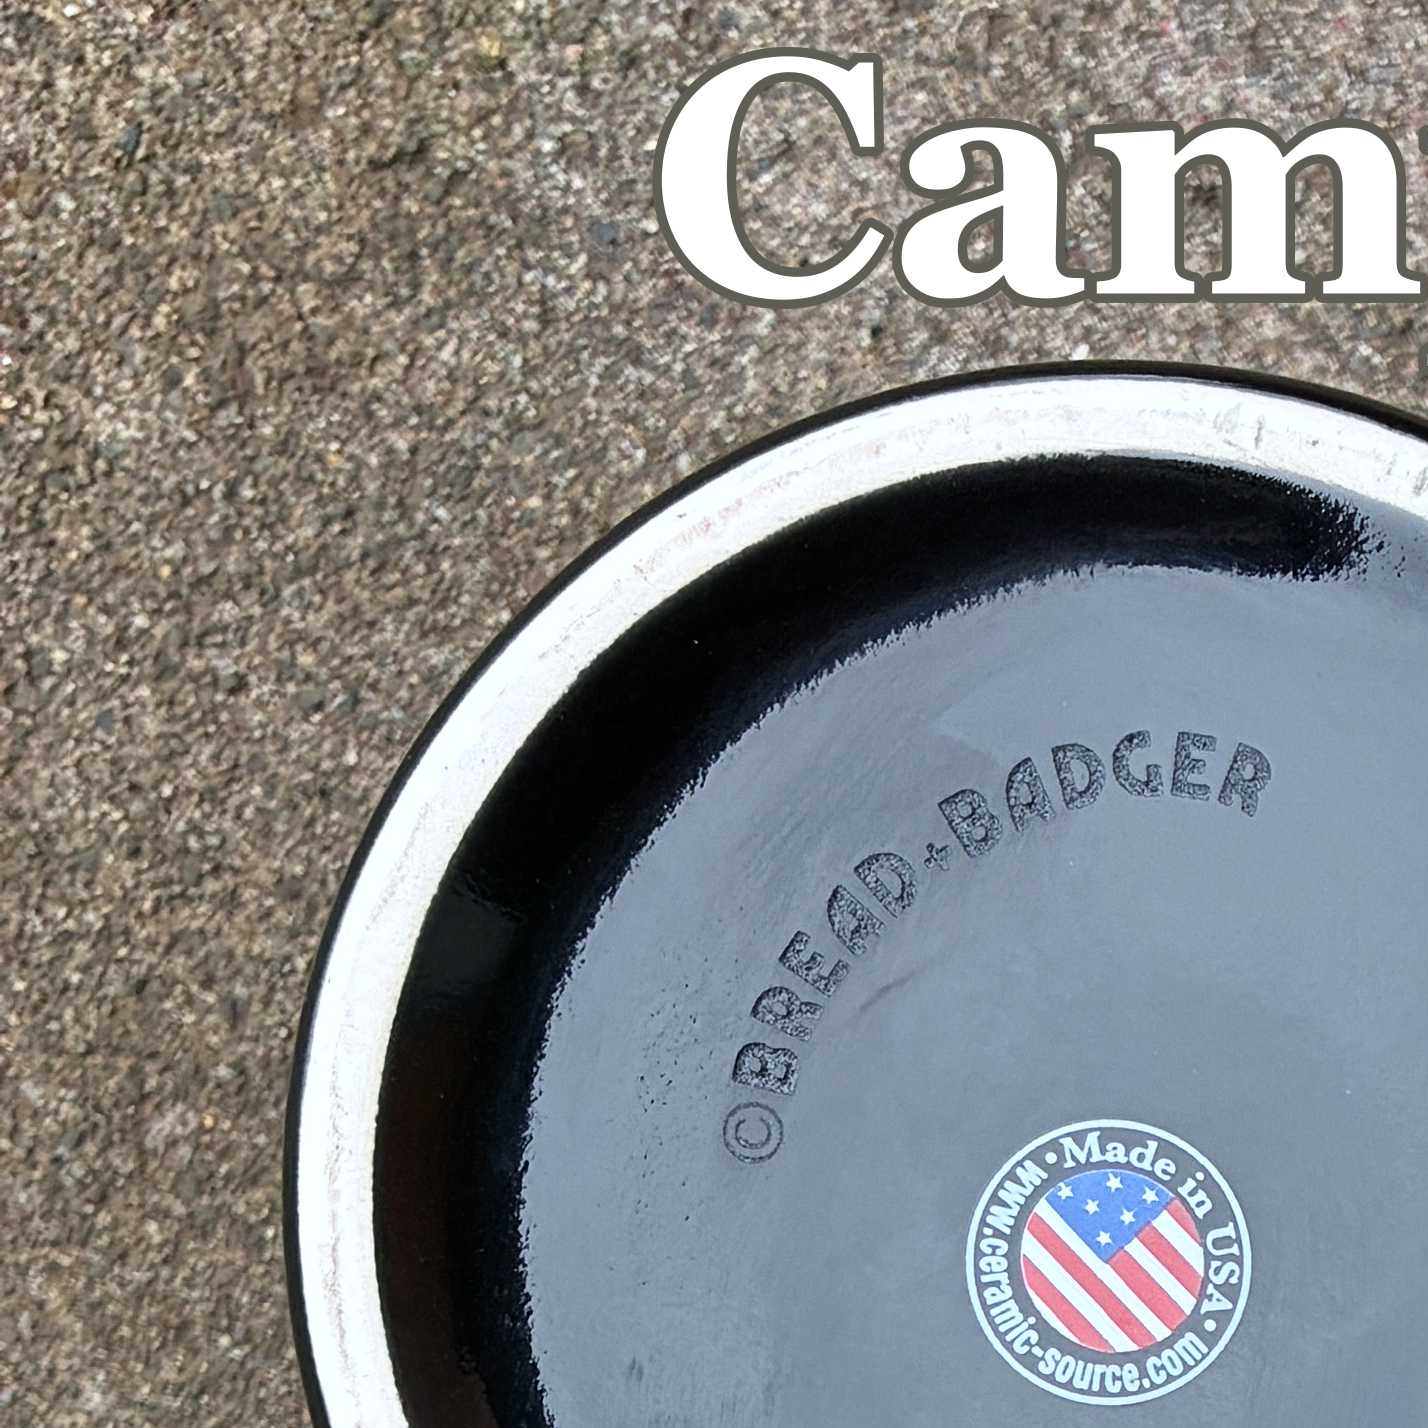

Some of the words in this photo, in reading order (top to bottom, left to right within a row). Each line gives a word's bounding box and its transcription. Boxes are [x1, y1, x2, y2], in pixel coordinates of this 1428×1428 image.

[978, 1159, 1209, 1394] www.ceramic-source.com
[1058, 1130, 1177, 1182] Made
[1177, 1171, 1214, 1220] in
[1199, 1221, 1241, 1316] USA
